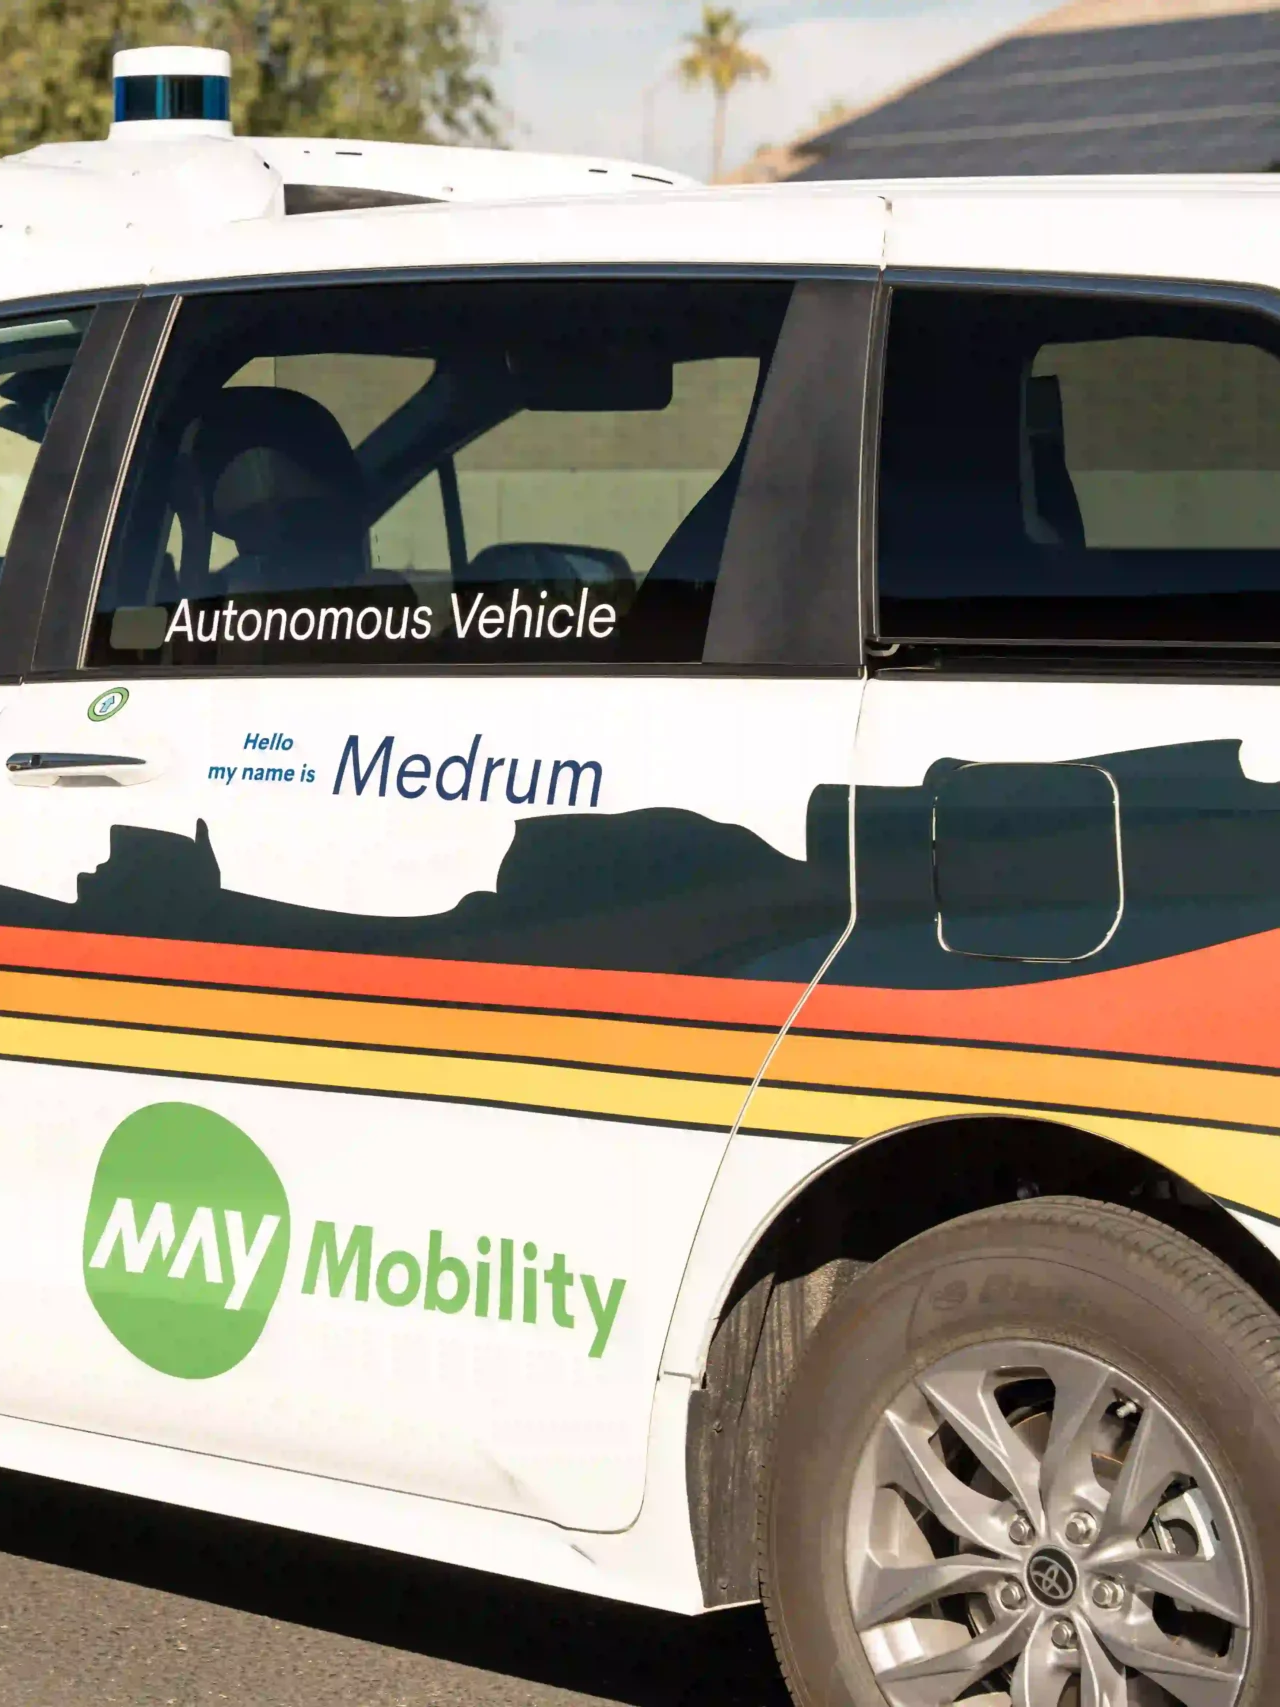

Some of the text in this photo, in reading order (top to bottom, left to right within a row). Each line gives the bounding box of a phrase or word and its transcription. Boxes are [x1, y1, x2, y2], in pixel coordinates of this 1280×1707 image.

[164, 588, 616, 643] Autonomous Vehicle
[243, 732, 294, 751] Hello
[207, 763, 316, 786] my name is
[331, 733, 603, 808] Medrum
[301, 1220, 627, 1359] Mobility
